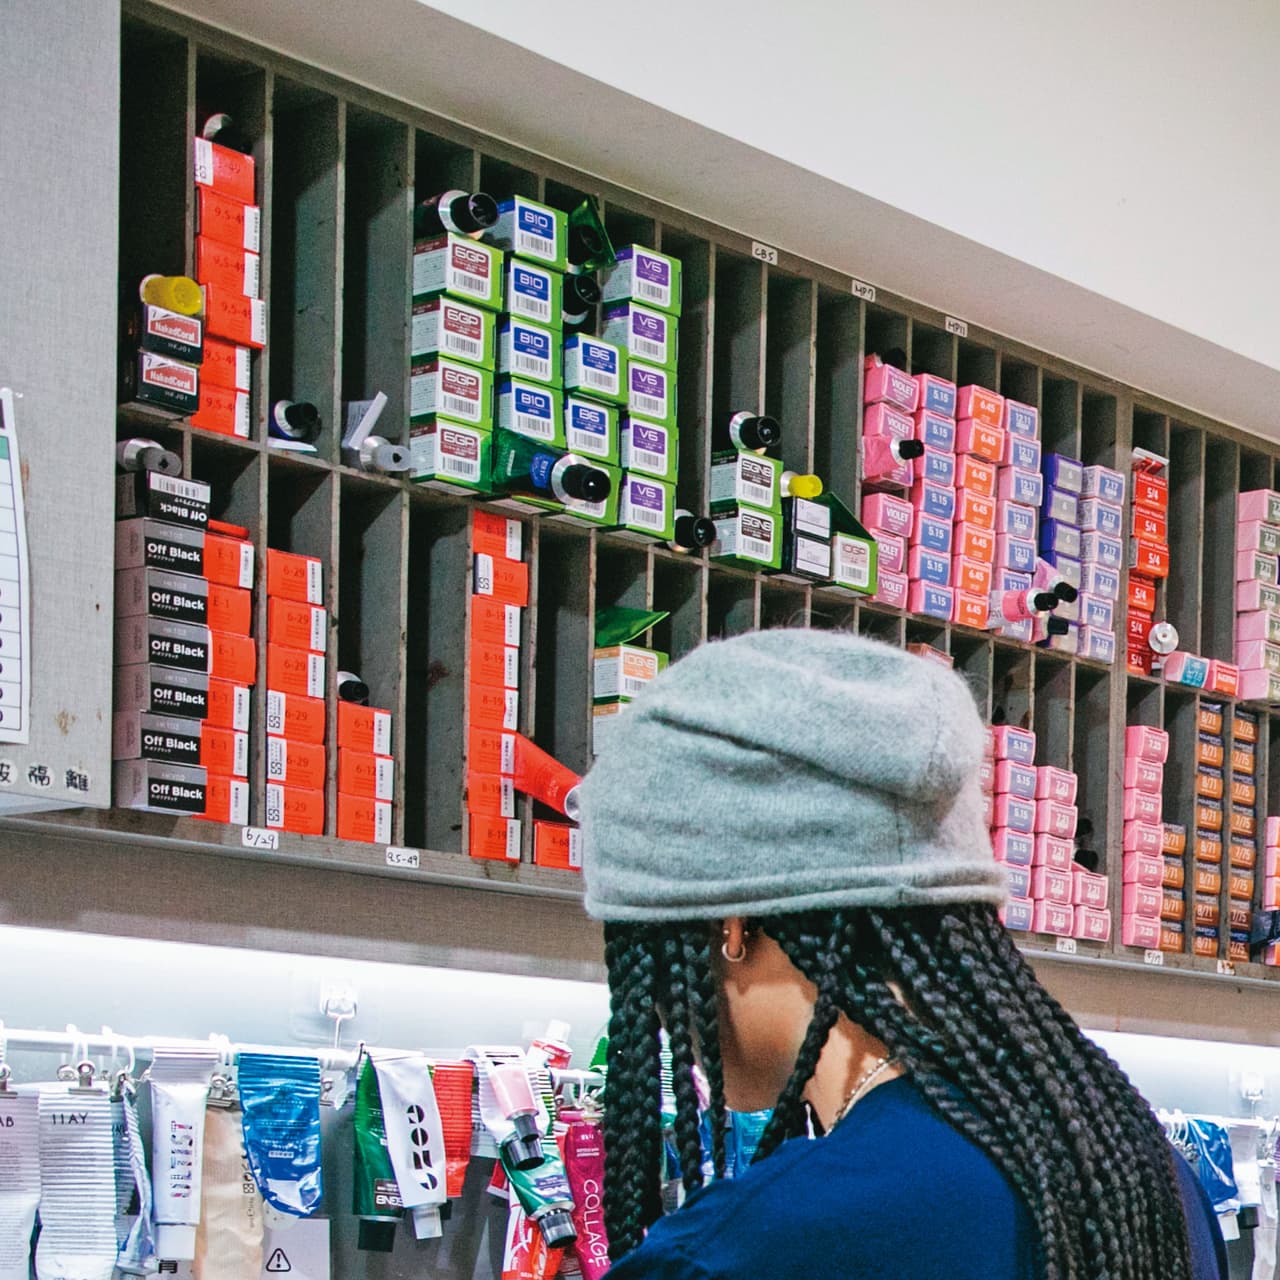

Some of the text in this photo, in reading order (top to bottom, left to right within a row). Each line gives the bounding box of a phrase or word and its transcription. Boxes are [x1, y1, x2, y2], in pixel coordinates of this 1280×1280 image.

[524, 212, 548, 228] B10
[454, 246, 487, 264] 6GP
[641, 258, 662, 273] V6
[519, 273, 543, 289] B10
[447, 309, 479, 326] 6GP
[638, 315, 658, 330] V6
[519, 332, 544, 348] B10
[589, 346, 610, 361] B6
[444, 370, 477, 386] 6GP
[638, 372, 657, 385] V6
[891, 378, 914, 397] VIOLET
[521, 392, 545, 408] B10
[579, 408, 600, 422] B6
[887, 416, 910, 434] VIOLET
[443, 431, 475, 446] 6GP
[639, 428, 658, 441] V6
[636, 485, 656, 498] V6
[1146, 487, 1159, 500] 5/4
[160, 503, 207, 523] Off Black
[886, 507, 909, 522] VIOLET
[1145, 521, 1157, 533] 5/4
[148, 542, 167, 555] Off
[169, 545, 201, 562] Black
[1148, 553, 1161, 565] 5/4
[881, 579, 903, 593] VIOLET
[1134, 588, 1147, 600] 5/4
[151, 592, 205, 611] Off Black
[1130, 621, 1143, 633] 5/4
[151, 640, 205, 659] Off Black
[1130, 654, 1143, 666] 5/4
[154, 688, 205, 706] Off Black
[144, 734, 197, 752] Off Black
[151, 783, 203, 801] Off Black
[583, 1179, 609, 1268] COLLAGE
